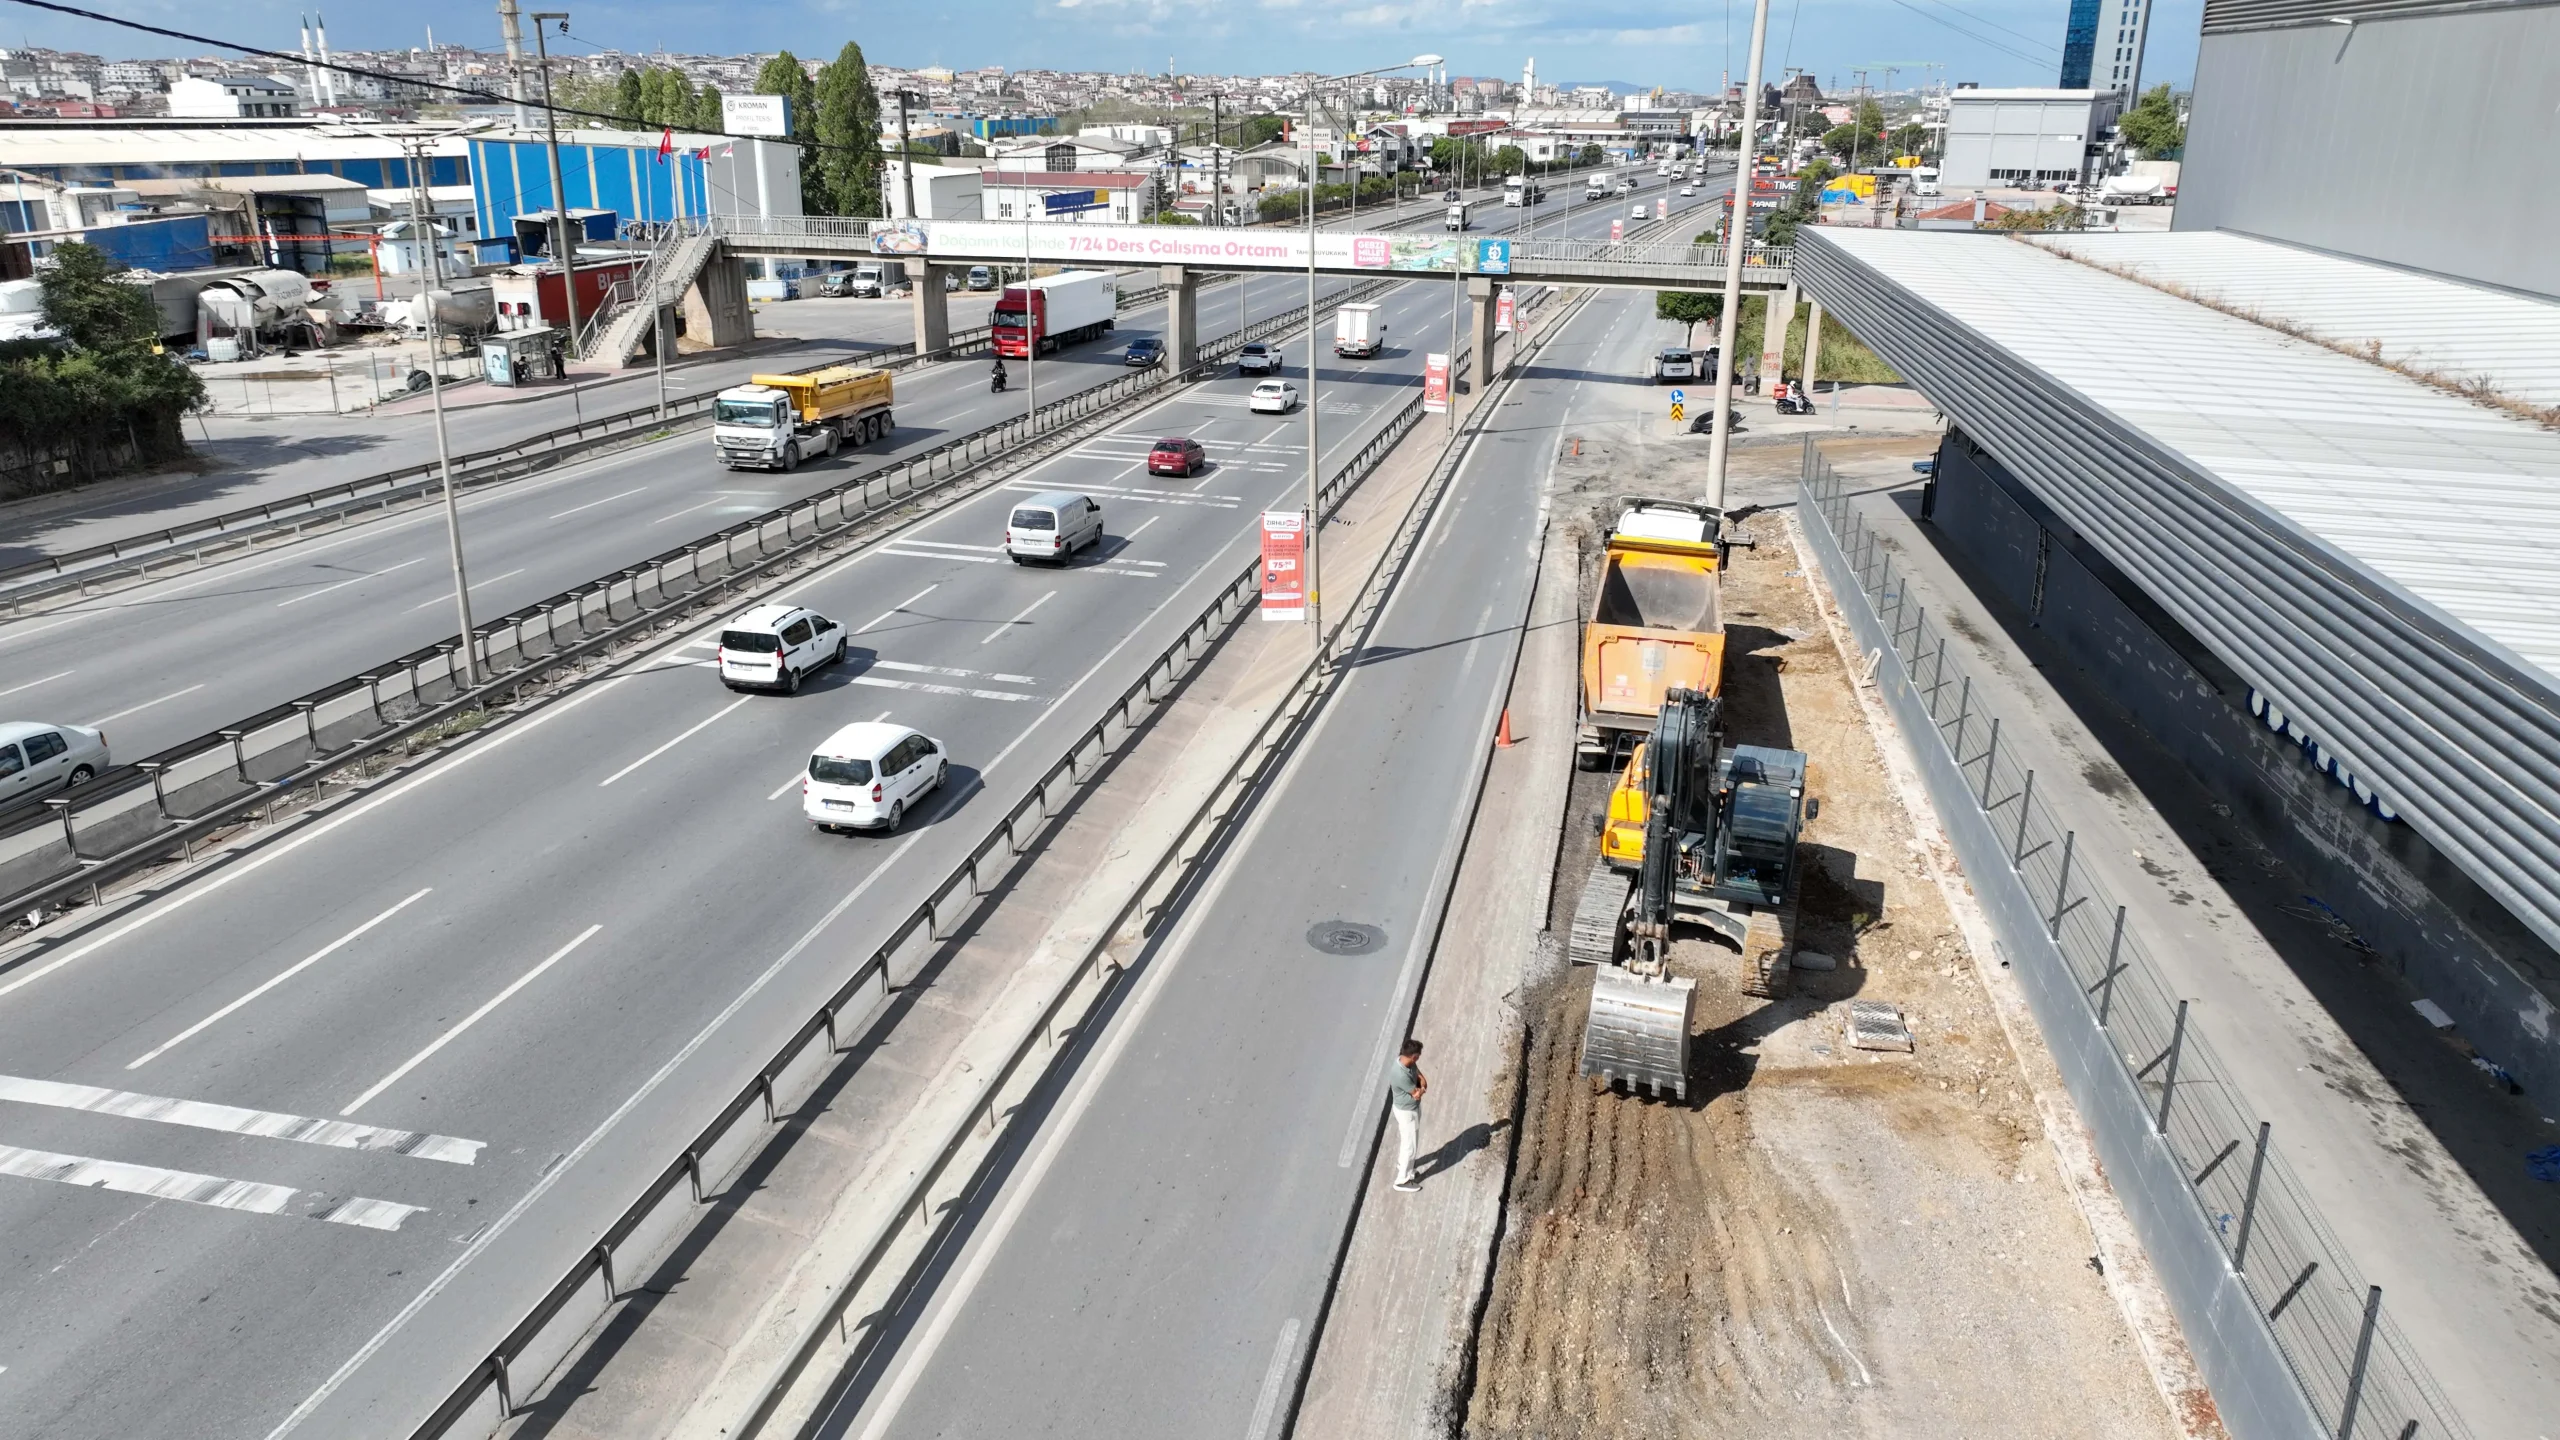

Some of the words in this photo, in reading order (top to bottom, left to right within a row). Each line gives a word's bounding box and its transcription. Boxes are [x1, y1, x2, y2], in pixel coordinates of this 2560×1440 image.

[1069, 236, 1103, 251] 7/24
[1107, 238, 1144, 253] Ders
[1225, 241, 1288, 258] Ortamı
